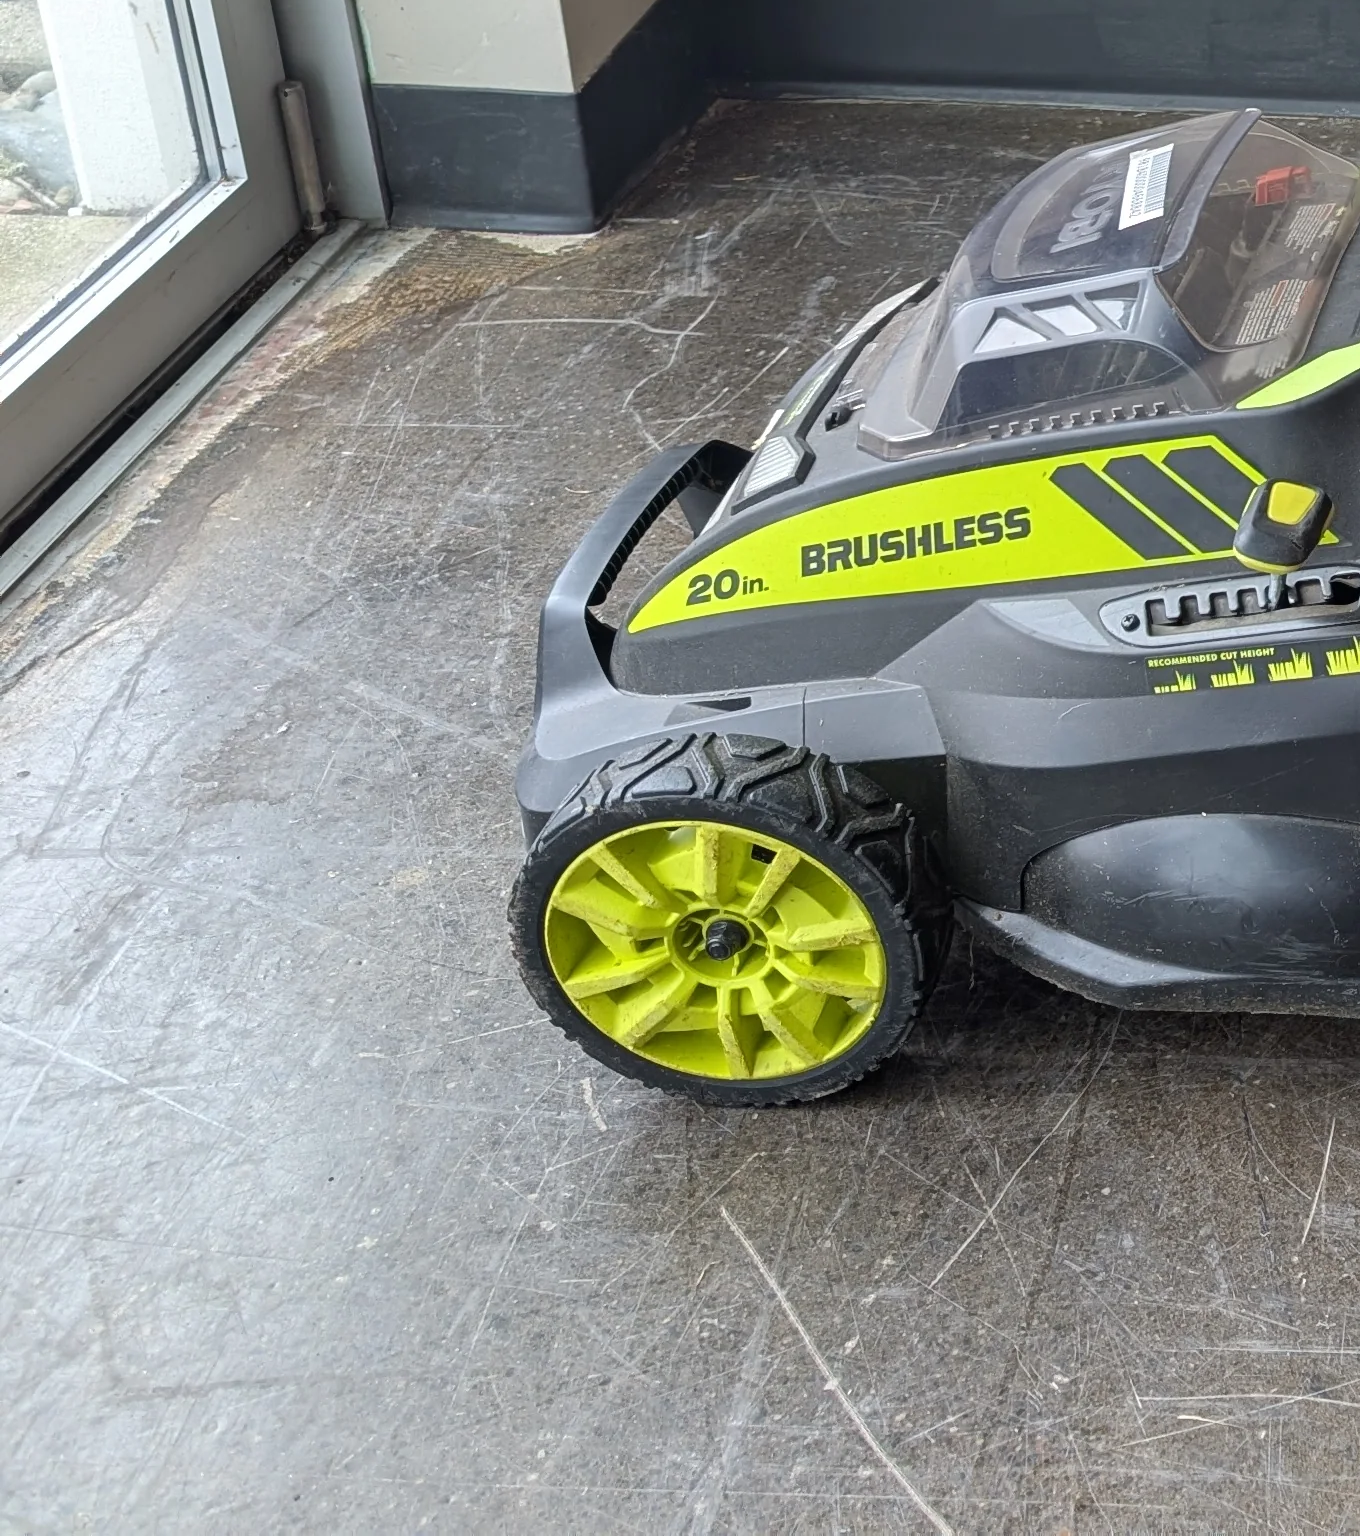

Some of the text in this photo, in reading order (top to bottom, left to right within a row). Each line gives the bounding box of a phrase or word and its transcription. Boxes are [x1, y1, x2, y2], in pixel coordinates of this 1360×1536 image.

[801, 506, 1032, 578] BRUSHLESS
[1147, 647, 1275, 668] RECOMMENDED CUT HEIGHT
